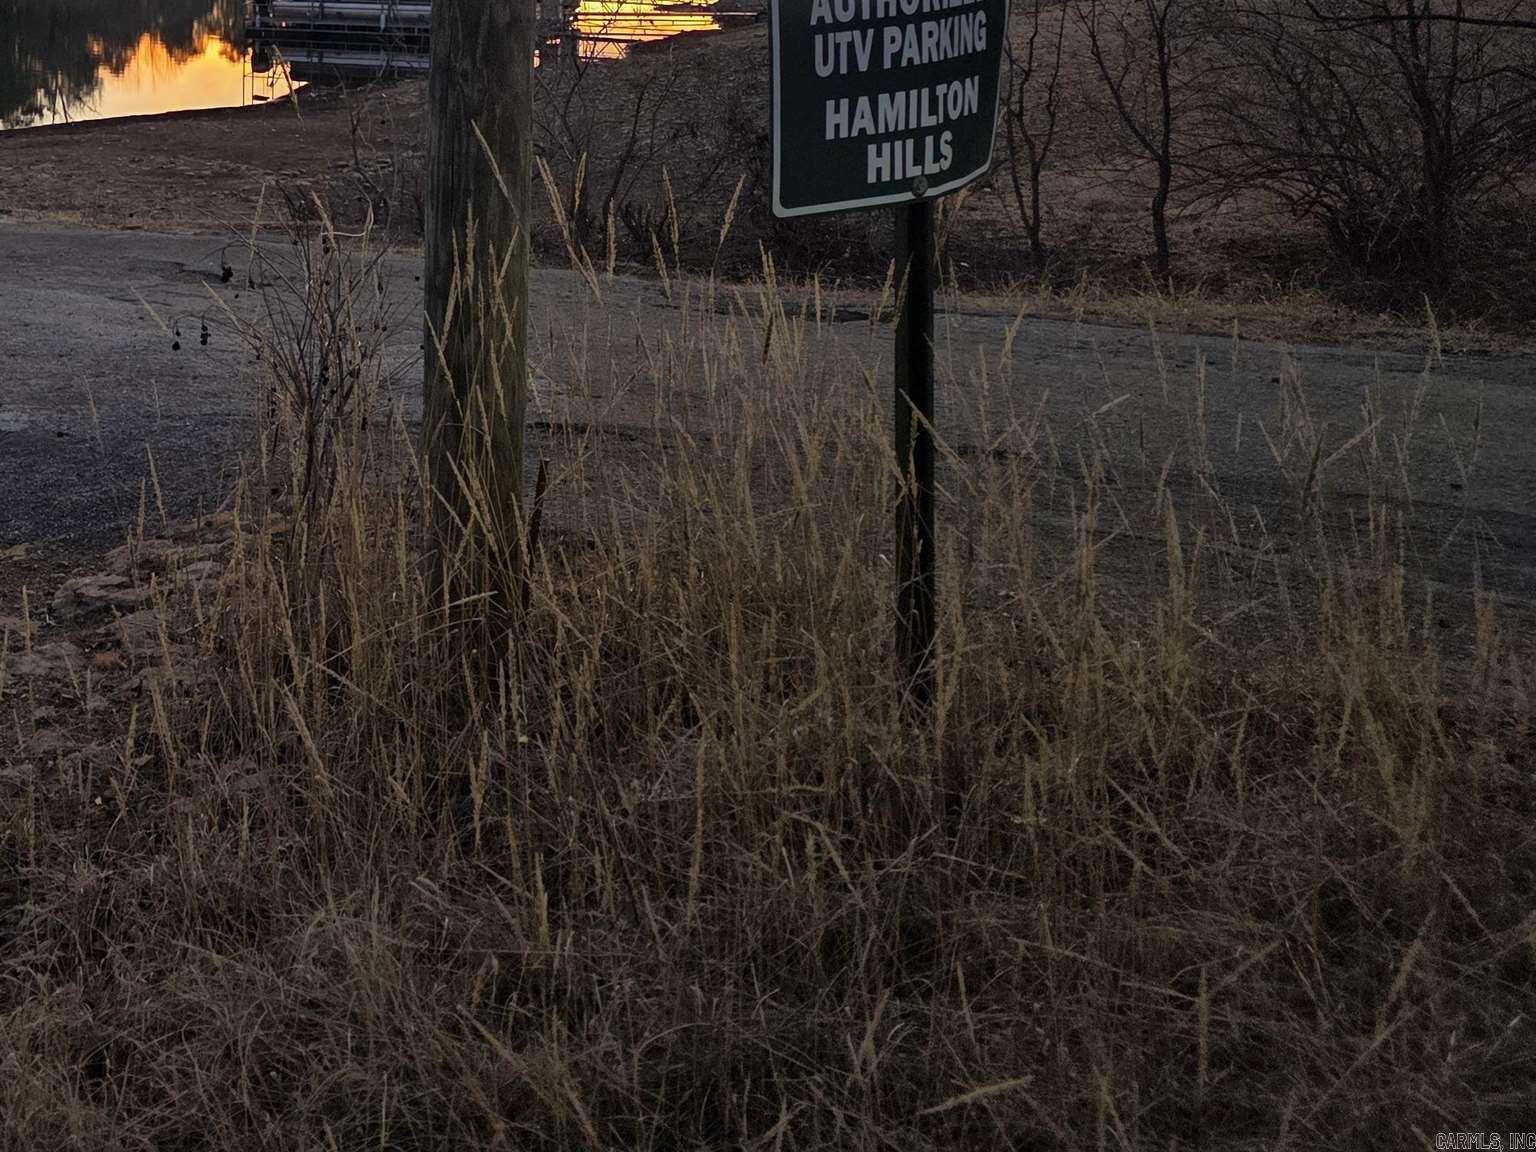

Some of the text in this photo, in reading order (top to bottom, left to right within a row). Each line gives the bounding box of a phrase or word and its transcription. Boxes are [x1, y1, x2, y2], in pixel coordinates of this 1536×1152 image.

[815, 10, 987, 78] UTV PARKING
[825, 75, 980, 141] HAMILTON
[867, 130, 953, 184] HILLS
